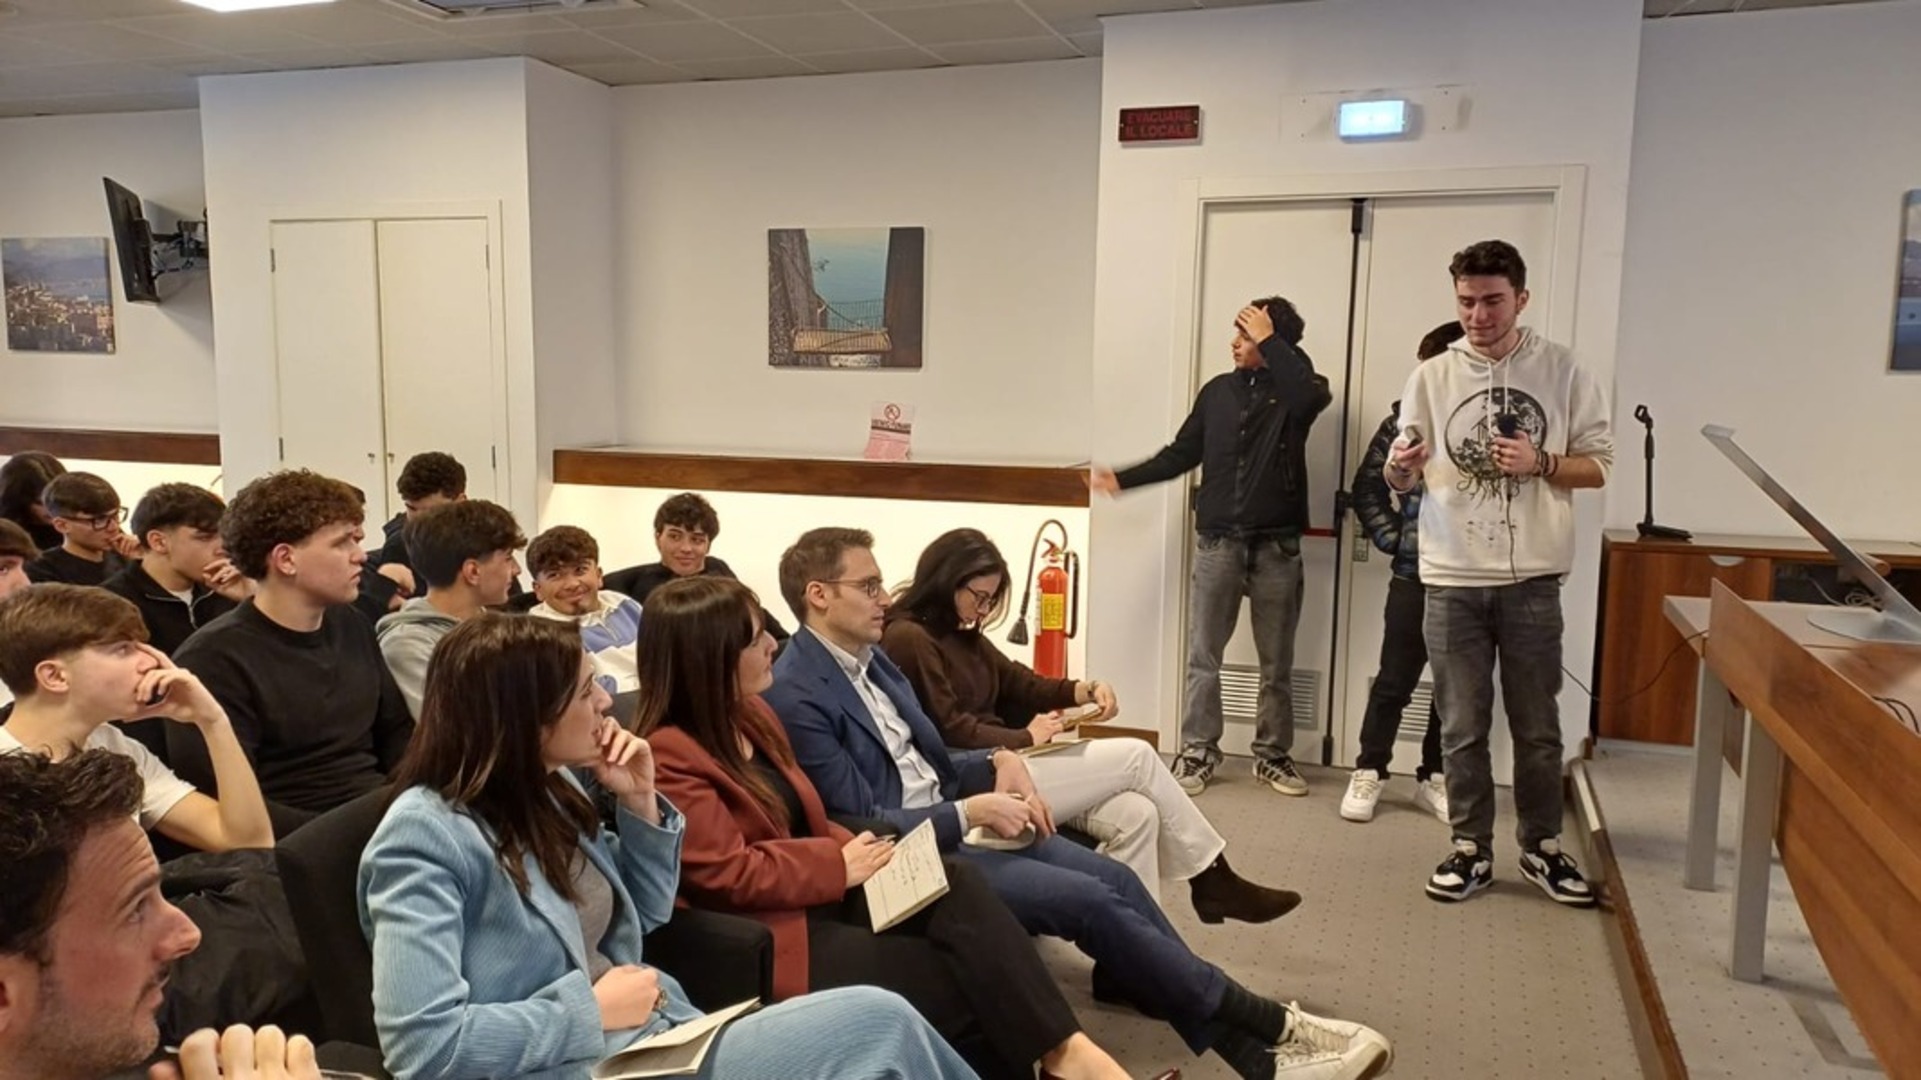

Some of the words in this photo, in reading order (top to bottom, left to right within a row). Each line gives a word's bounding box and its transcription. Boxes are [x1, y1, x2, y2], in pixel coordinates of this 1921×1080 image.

[1127, 109, 1191, 124] EVACUARE
[1126, 126, 1136, 138] IL
[1140, 123, 1193, 138] LOCALE
